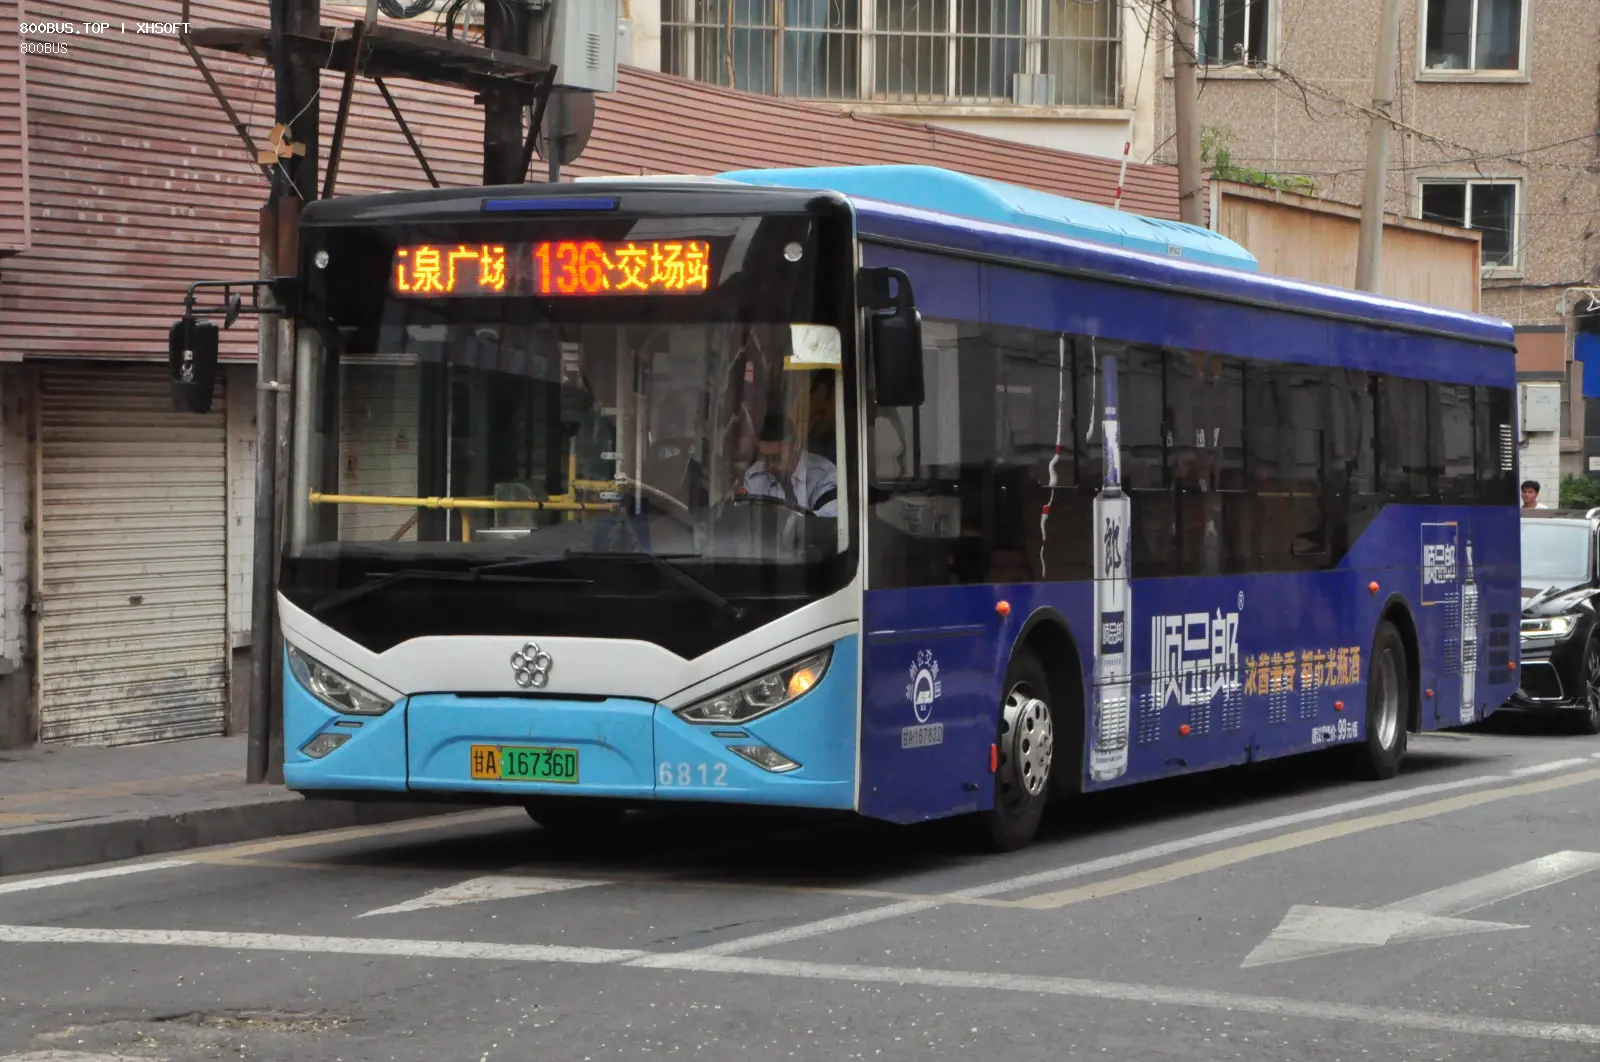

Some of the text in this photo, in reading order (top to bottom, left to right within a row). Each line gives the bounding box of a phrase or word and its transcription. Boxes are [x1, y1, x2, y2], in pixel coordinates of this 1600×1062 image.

[536, 242, 602, 293] 136
[1150, 606, 1240, 709] 顺品郎
[659, 761, 729, 787] 6812
